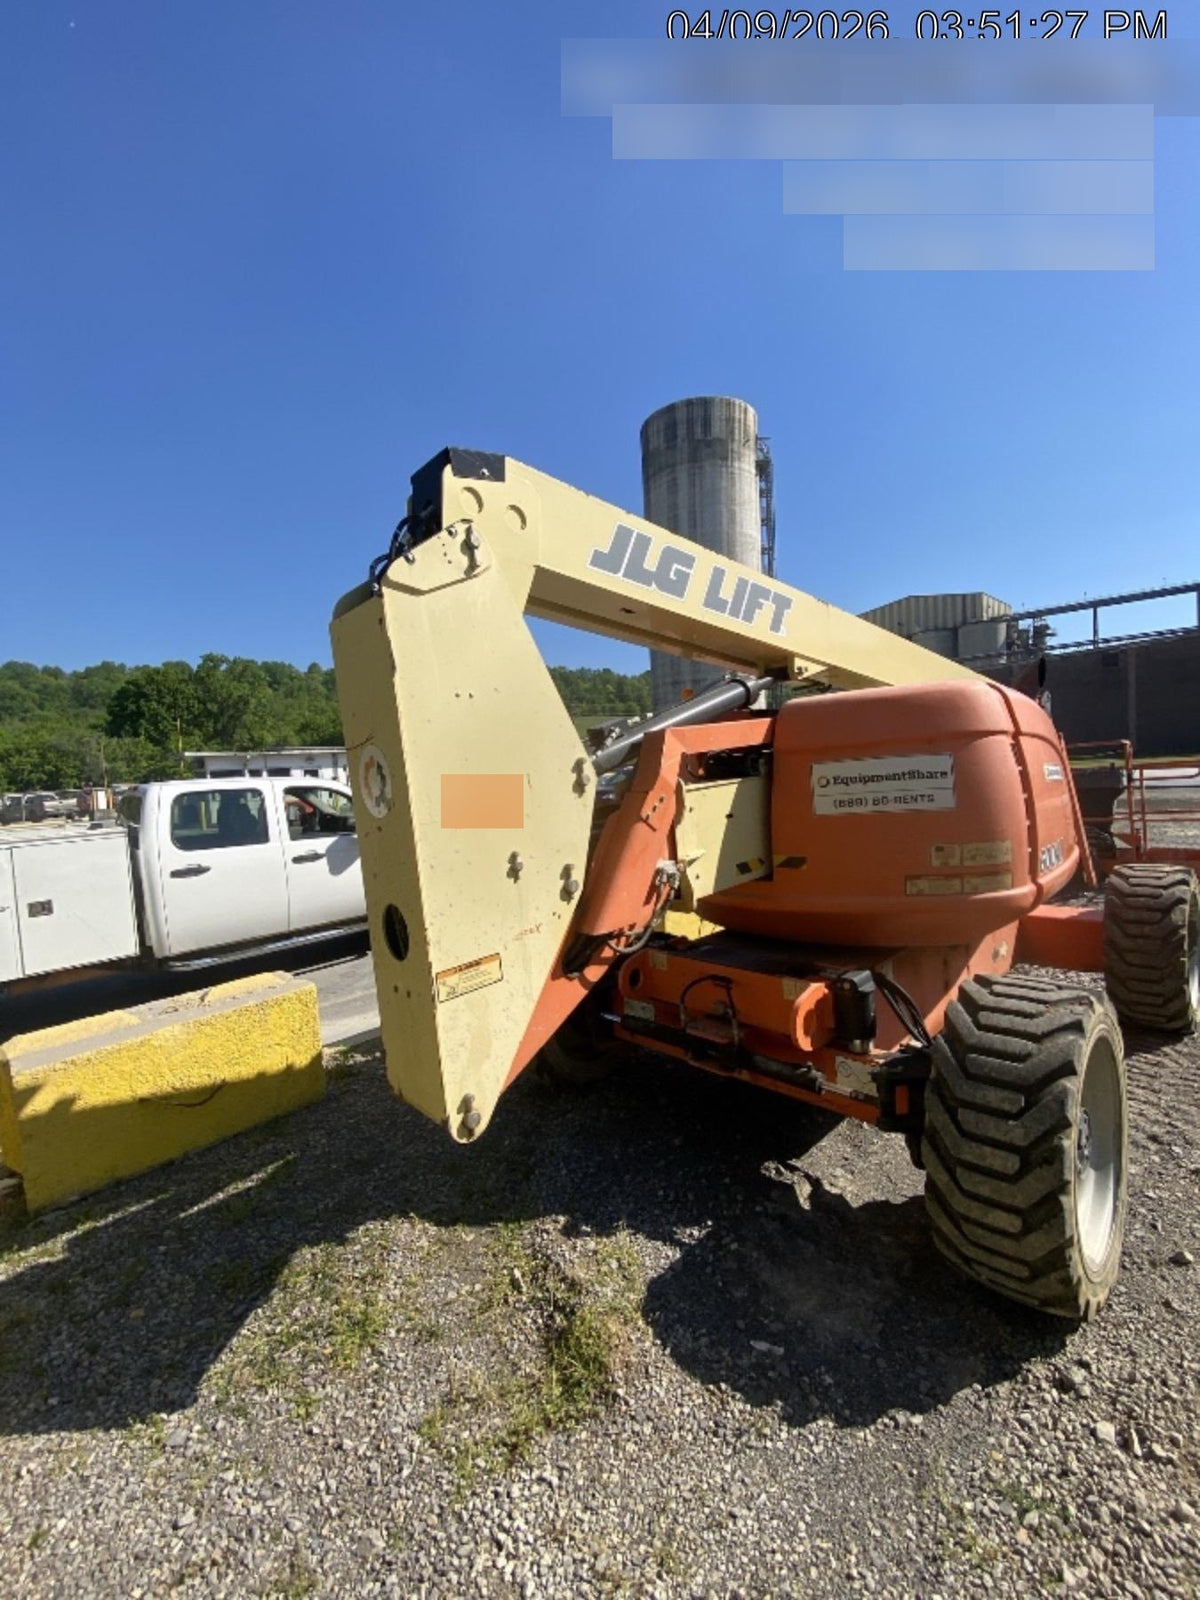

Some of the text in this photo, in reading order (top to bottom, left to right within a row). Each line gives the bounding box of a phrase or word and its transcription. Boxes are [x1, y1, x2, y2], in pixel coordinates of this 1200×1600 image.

[588, 523, 794, 635] JLG LIFT
[832, 769, 949, 787] EquipmentShare
